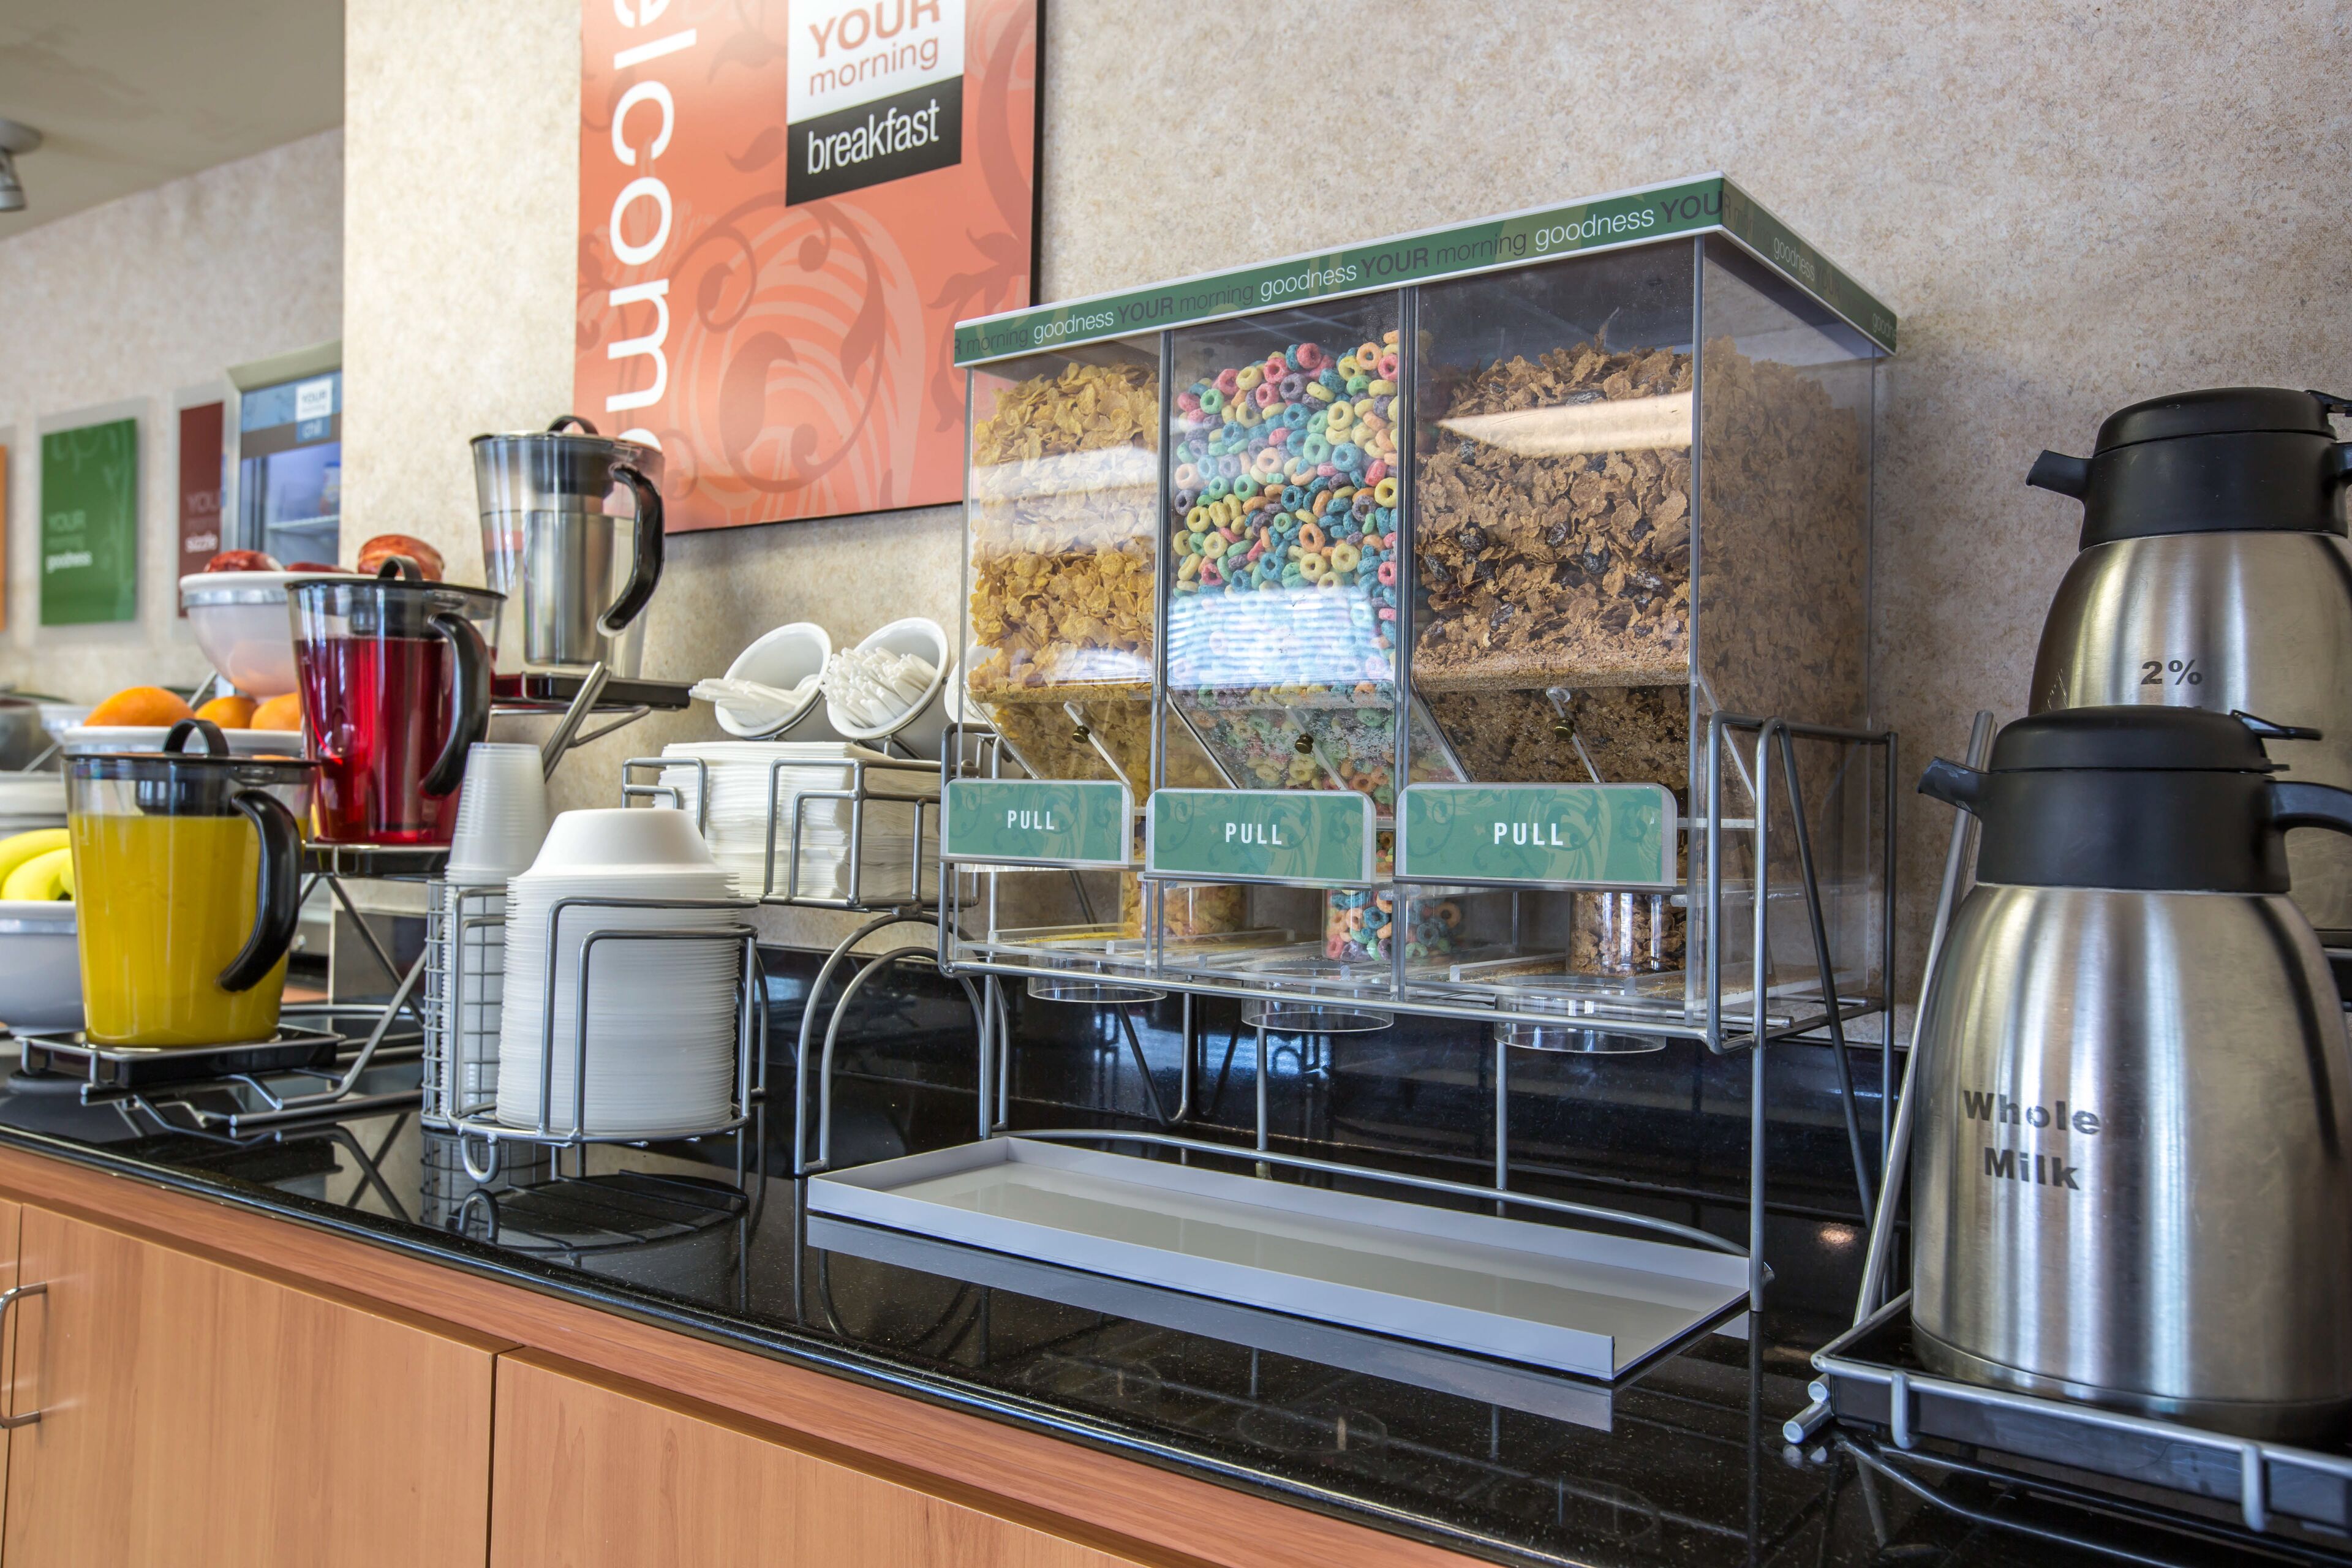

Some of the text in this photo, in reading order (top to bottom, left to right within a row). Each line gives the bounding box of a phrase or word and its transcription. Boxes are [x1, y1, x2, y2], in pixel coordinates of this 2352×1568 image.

[809, 0, 940, 59] YOUR
[809, 37, 939, 96] morning
[807, 98, 940, 175] breakfast
[966, 328, 1028, 353] morning
[1033, 311, 1114, 345] goodness
[1117, 296, 1174, 324] YOUR
[1180, 284, 1254, 313] morning
[1261, 264, 1357, 303] goodness
[1360, 247, 1429, 279] YOUR
[1436, 233, 1527, 266] morning
[1535, 208, 1655, 252] goodness
[1774, 237, 1815, 282] goodness
[2140, 659, 2203, 685] 2%
[1007, 810, 1055, 831] PULL
[1226, 822, 1283, 846] PULL
[1493, 821, 1564, 846] PULL
[1963, 1090, 2101, 1135] Whole
[1984, 1147, 2080, 1191] Milk
